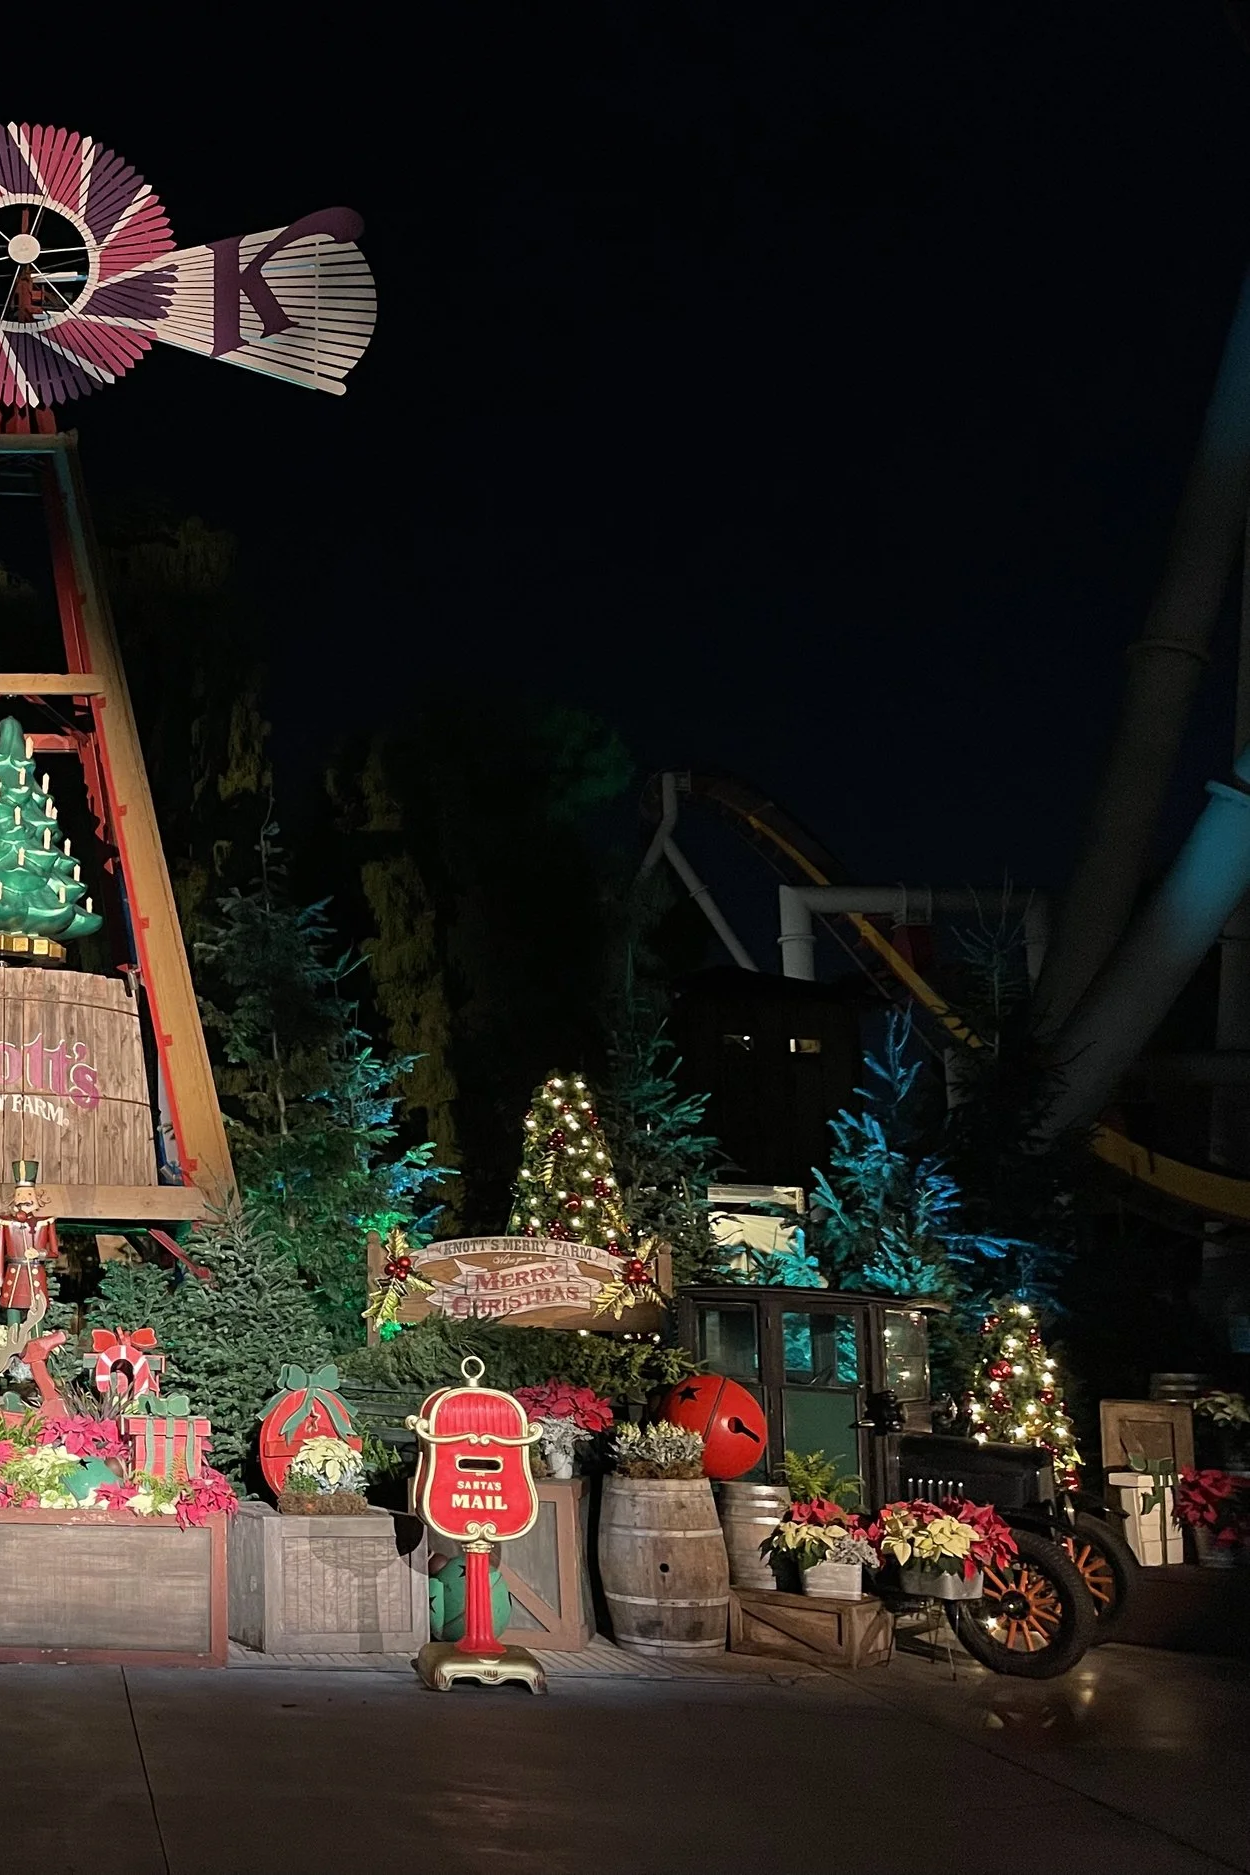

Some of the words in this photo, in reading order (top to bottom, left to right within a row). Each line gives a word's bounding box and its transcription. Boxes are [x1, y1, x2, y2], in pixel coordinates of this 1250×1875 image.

[206, 206, 365, 359] K
[443, 1238, 500, 1255] KNOTT'S
[503, 1238, 548, 1252] MERRY
[554, 1242, 592, 1259] FARM
[475, 1264, 562, 1291] MERRY
[456, 1480, 502, 1491] SANTA'S
[451, 1493, 508, 1510] MAIL
